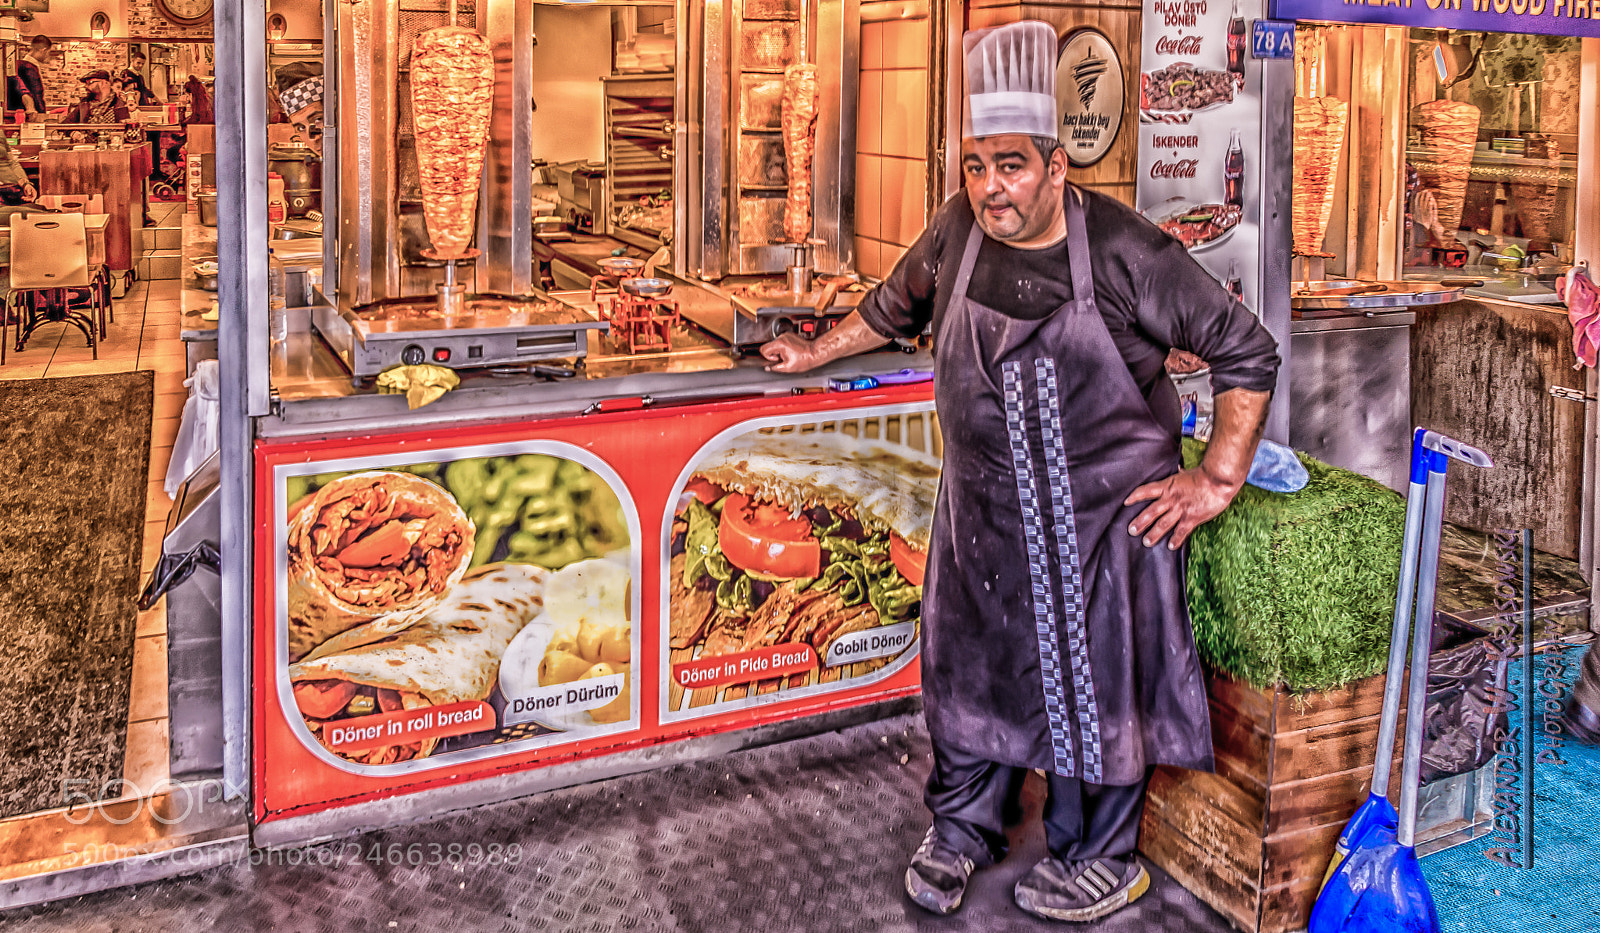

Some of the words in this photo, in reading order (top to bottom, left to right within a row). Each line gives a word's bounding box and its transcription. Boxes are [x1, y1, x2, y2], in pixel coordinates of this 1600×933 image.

[1164, 12, 1197, 27] DÖNER
[1255, 31, 1275, 51] 78
[1279, 31, 1293, 52] A
[1097, 112, 1110, 131] bey
[834, 637, 868, 656] Gobit
[871, 633, 908, 652] Döner
[680, 666, 720, 684] Döner
[724, 662, 737, 676] in
[740, 657, 768, 673] Pide
[772, 648, 809, 667] Bread
[513, 693, 562, 714] Döner
[565, 683, 619, 705] Dürüm
[331, 724, 384, 746] Döner
[386, 719, 401, 736] in
[407, 713, 433, 732] roll
[437, 704, 483, 727] bread
